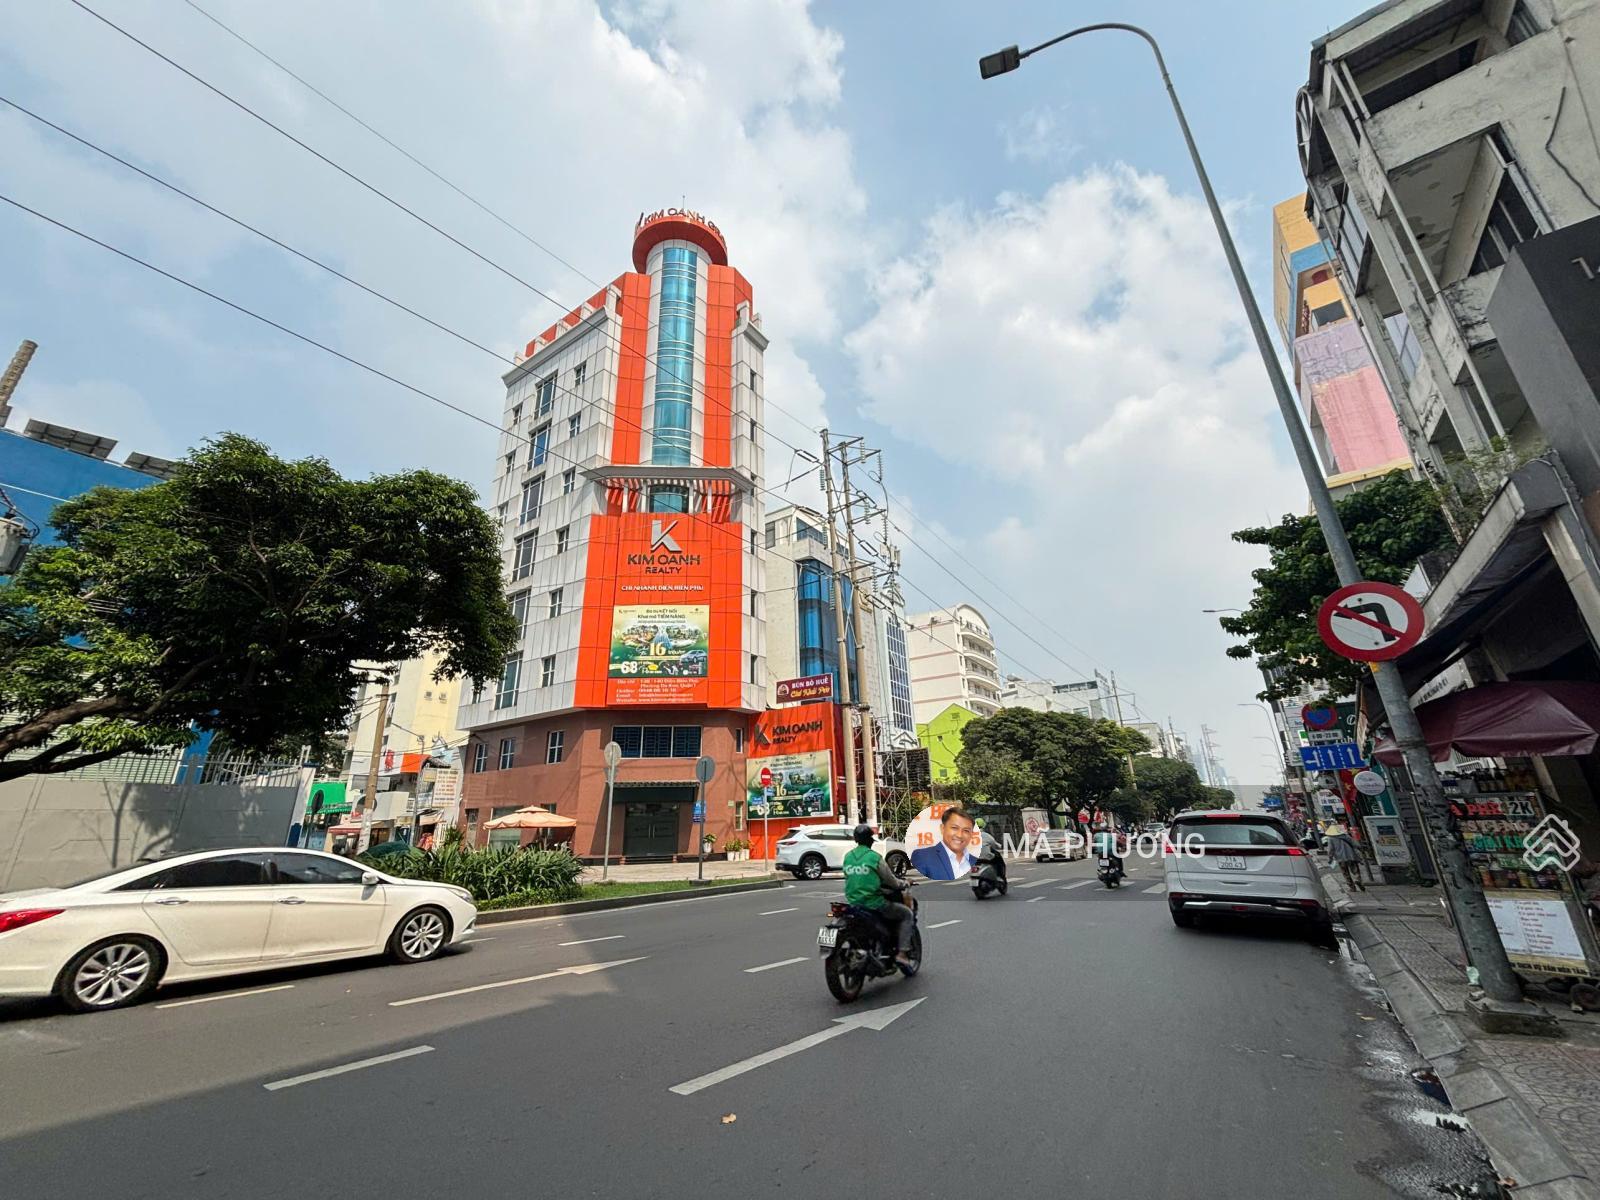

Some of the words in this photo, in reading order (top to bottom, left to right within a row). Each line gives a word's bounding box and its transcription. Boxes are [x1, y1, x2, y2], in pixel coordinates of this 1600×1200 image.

[644, 209, 664, 225] KIM
[668, 207, 706, 224] OANH
[627, 554, 655, 565] KIM
[657, 554, 701, 565] OANH
[650, 642, 666, 656] 16
[621, 661, 638, 674] 68
[805, 679, 815, 687] BÒ
[772, 725, 790, 736] KIM
[791, 721, 823, 733] OANH
[772, 736, 797, 744] REALTY
[1508, 801, 1534, 815] 2K
[845, 864, 870, 875] Grab
